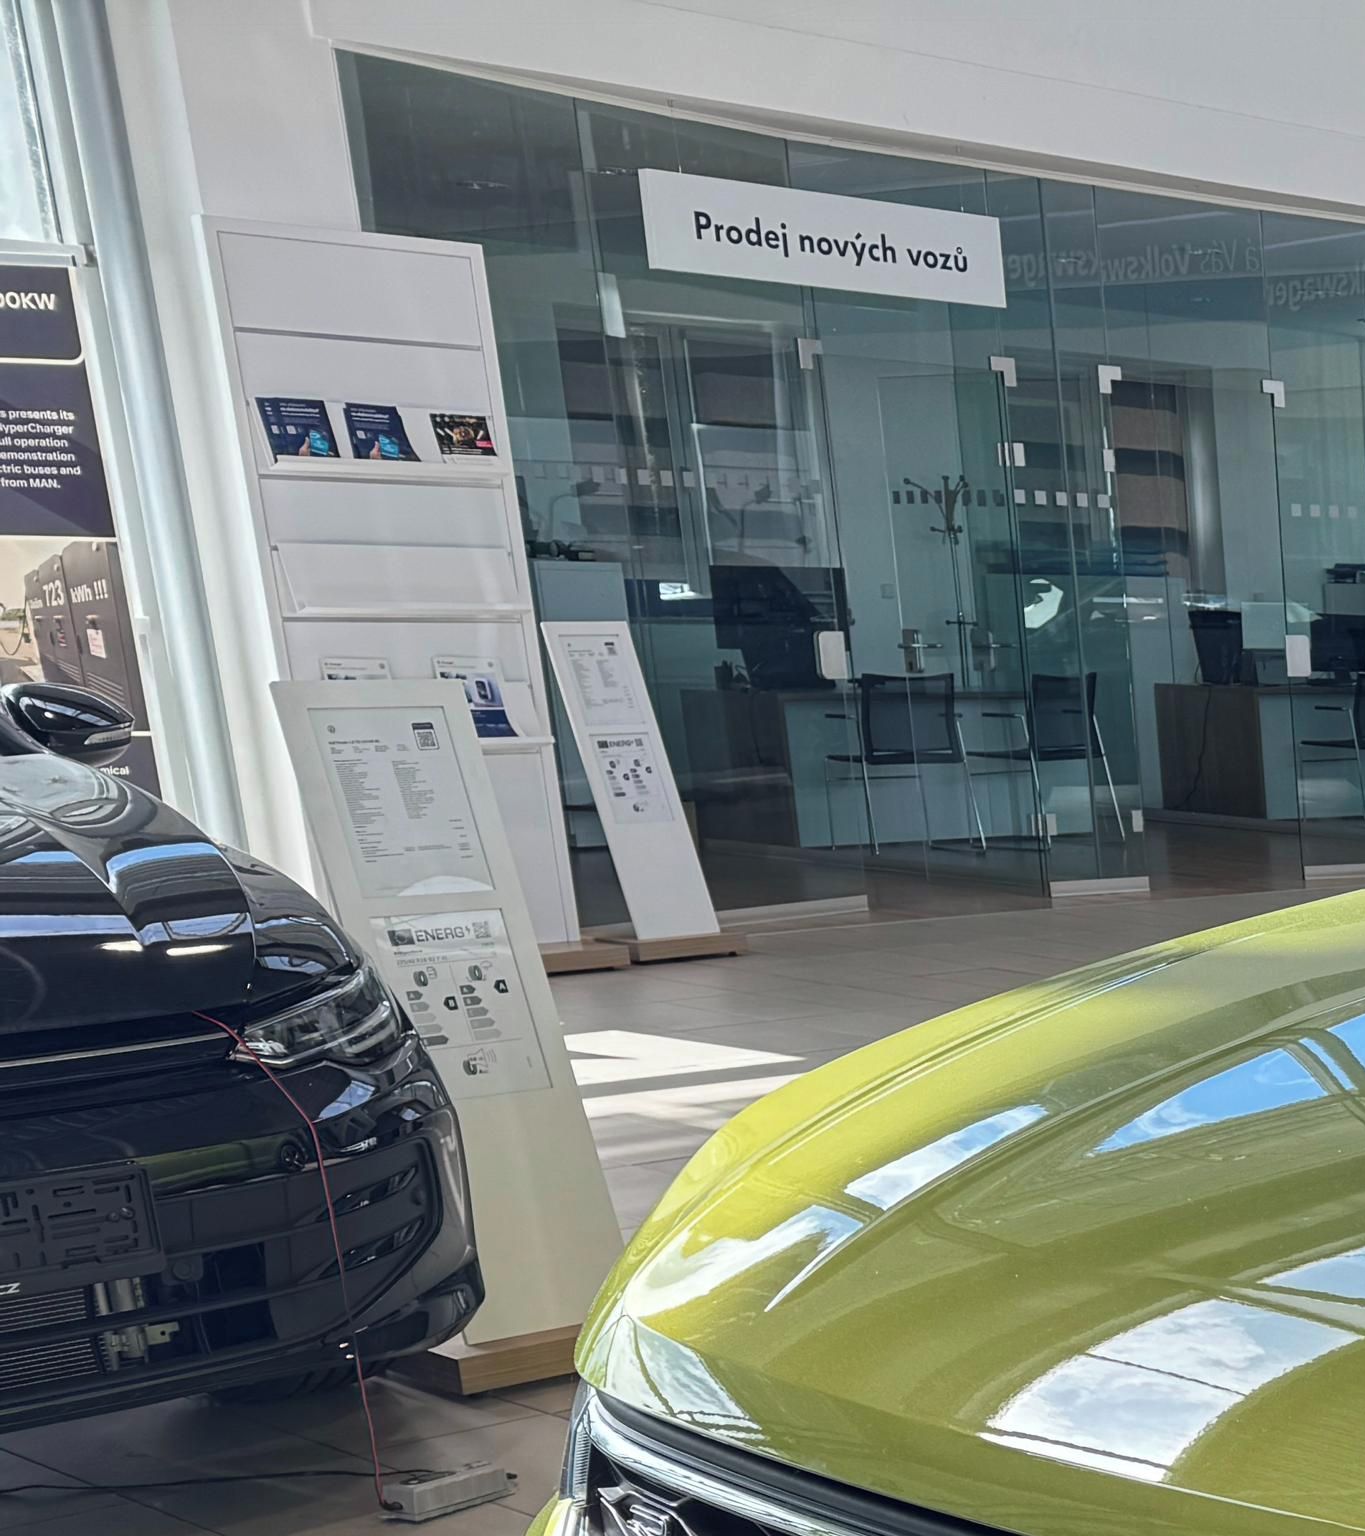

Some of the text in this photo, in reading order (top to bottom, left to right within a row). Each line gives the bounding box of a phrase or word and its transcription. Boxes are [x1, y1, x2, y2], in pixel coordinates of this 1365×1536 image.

[693, 211, 968, 273] Prodej nových vozů
[8, 409, 59, 420] presents
[59, 409, 75, 420] its
[14, 437, 69, 448] operation
[23, 464, 58, 475] buses
[60, 465, 82, 475] and
[1, 478, 61, 488] from MAN.
[42, 579, 65, 607] 723
[414, 926, 465, 943] ENERG
